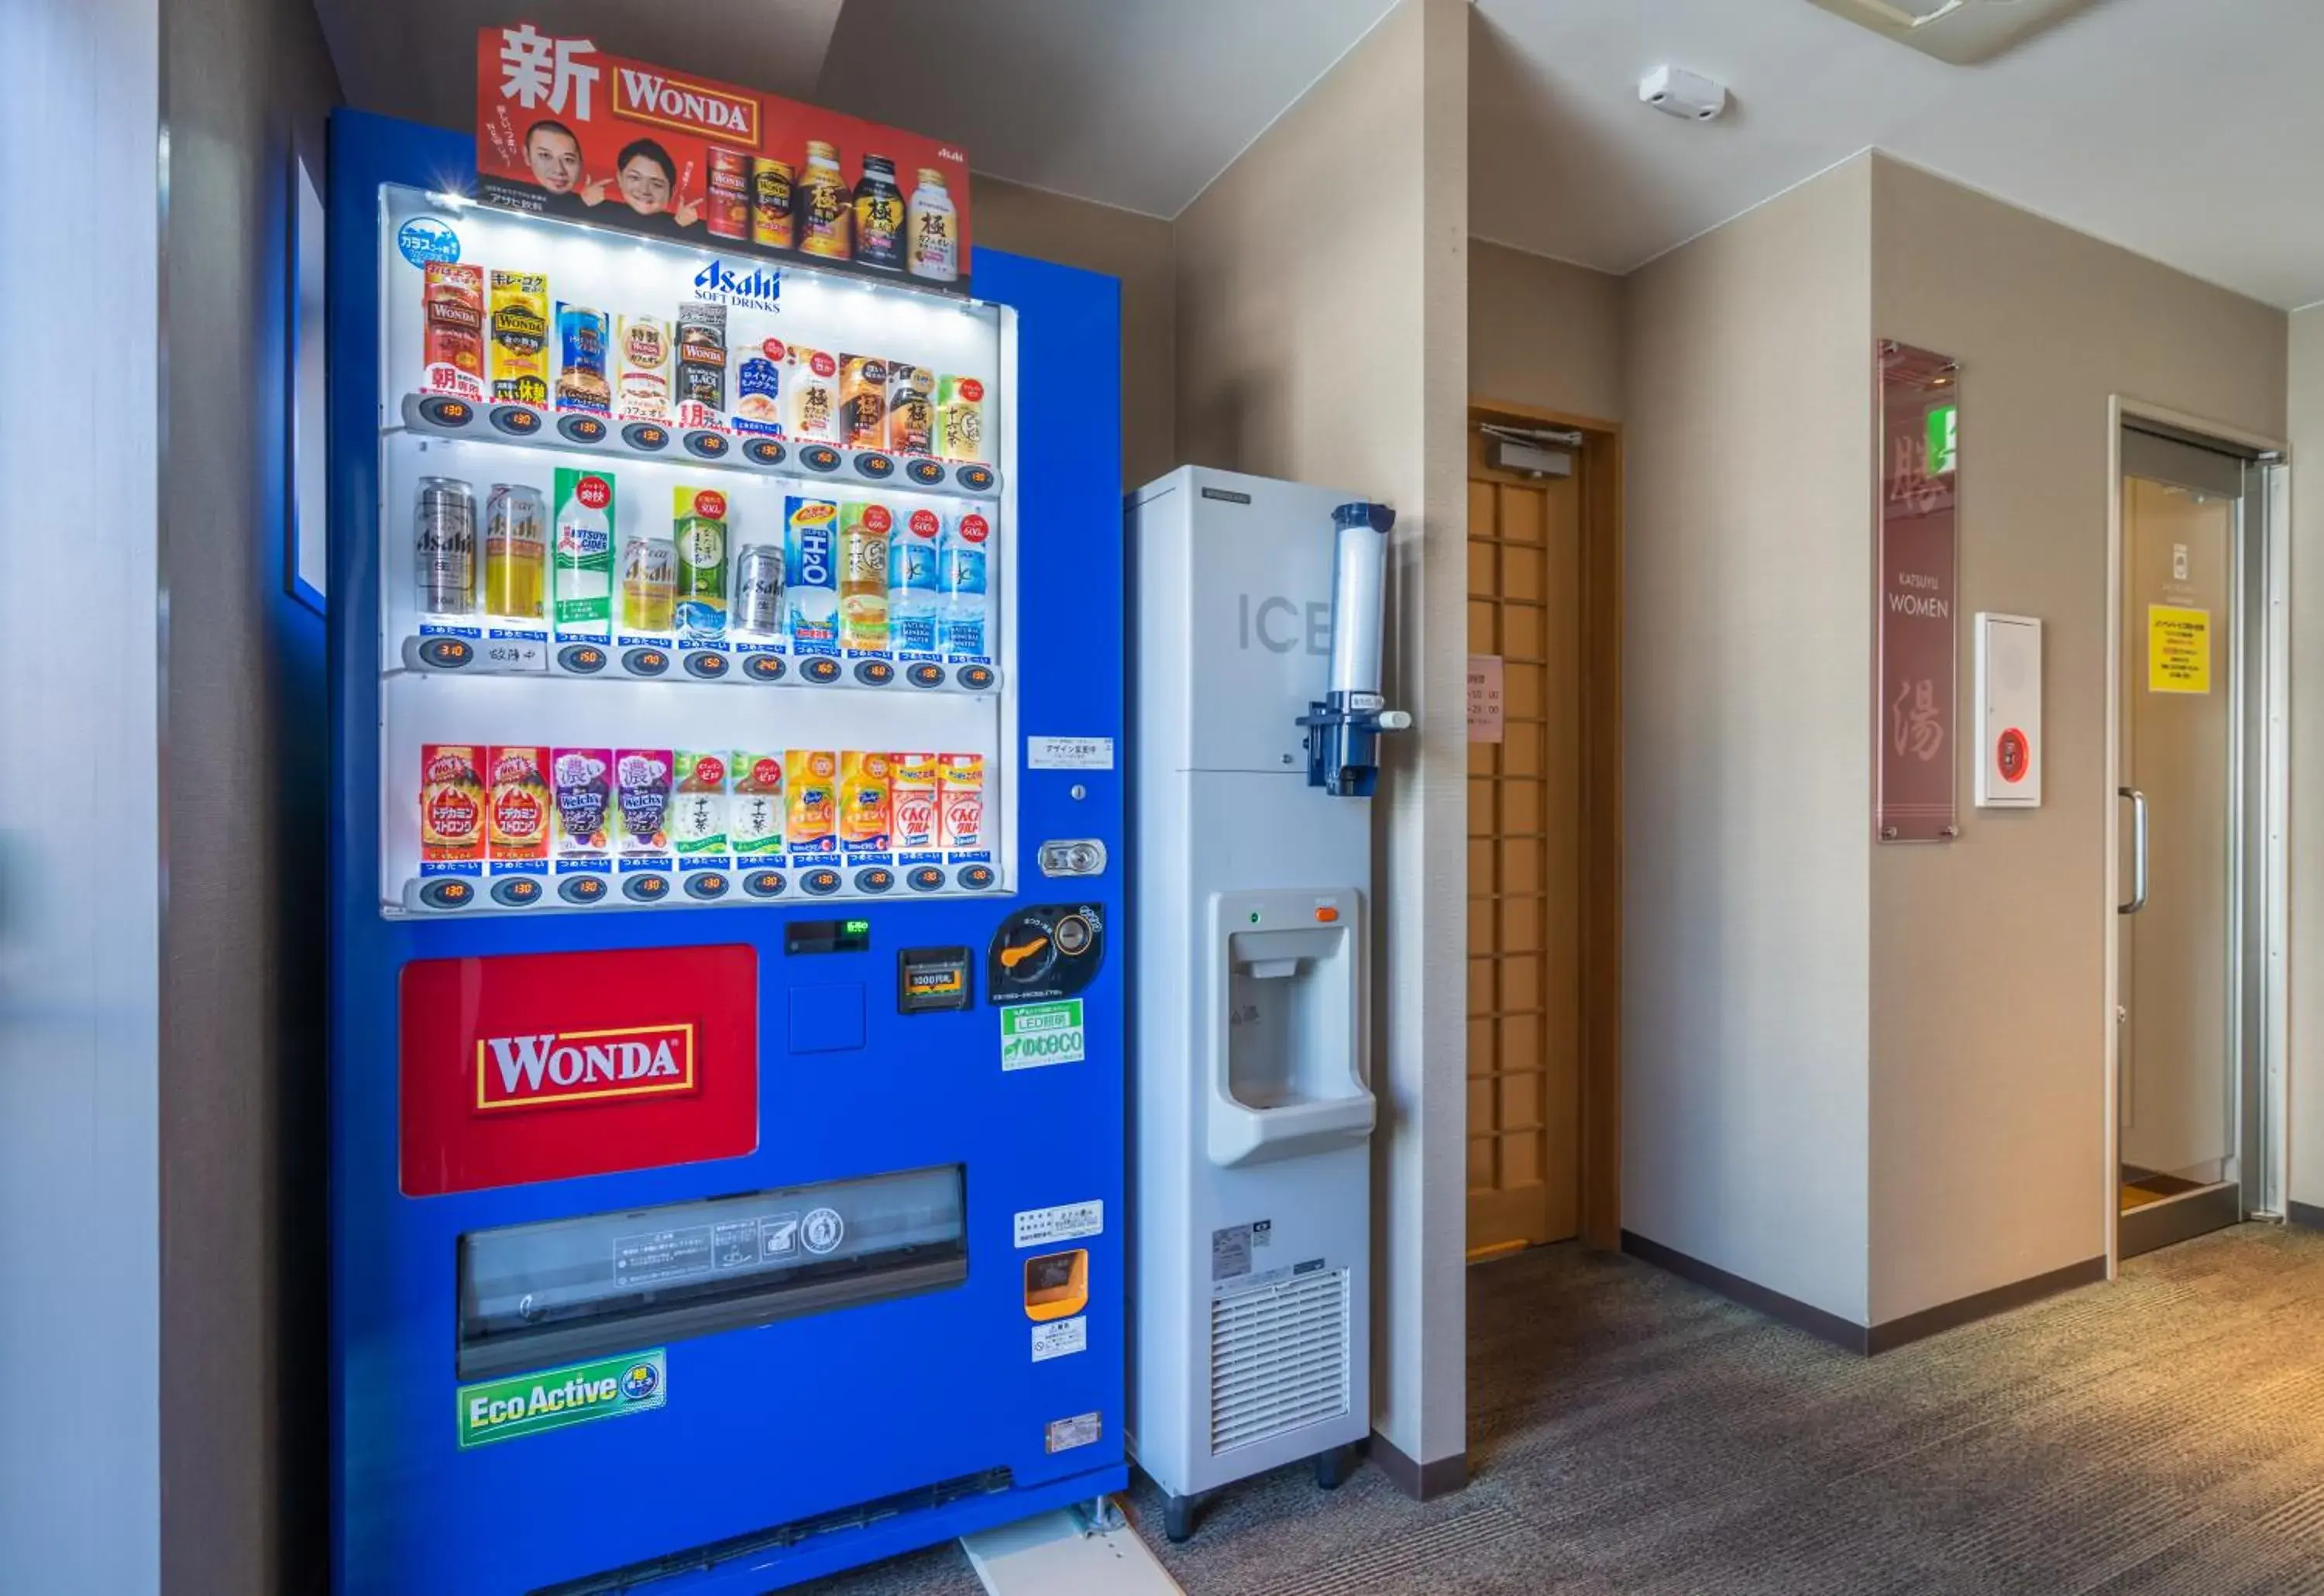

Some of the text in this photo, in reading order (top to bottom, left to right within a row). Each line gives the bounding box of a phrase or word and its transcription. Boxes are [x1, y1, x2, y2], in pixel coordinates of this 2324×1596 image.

[500, 24, 599, 122] 新
[621, 67, 749, 133] WONDA
[490, 191, 542, 211] アサヒ飲料
[867, 198, 894, 224] 極
[921, 212, 947, 238] 極
[694, 260, 782, 301] Asahi
[694, 289, 781, 314] SOFT DRINKS
[433, 303, 476, 324] WONDA
[498, 314, 542, 333] WONDA
[685, 343, 722, 363] WONDA
[444, 404, 463, 417] 130
[579, 422, 597, 433] 130
[644, 429, 660, 442] 130
[417, 529, 472, 554] Asahi
[582, 538, 607, 550] CIDER
[1889, 591, 1949, 620] WOMEN
[1239, 593, 1334, 656] ICE
[439, 645, 463, 656] 310
[1892, 679, 1944, 762] 湯
[514, 883, 532, 893] 130
[818, 874, 833, 885] 130
[445, 885, 464, 897] 130
[488, 1033, 680, 1094] WONDA
